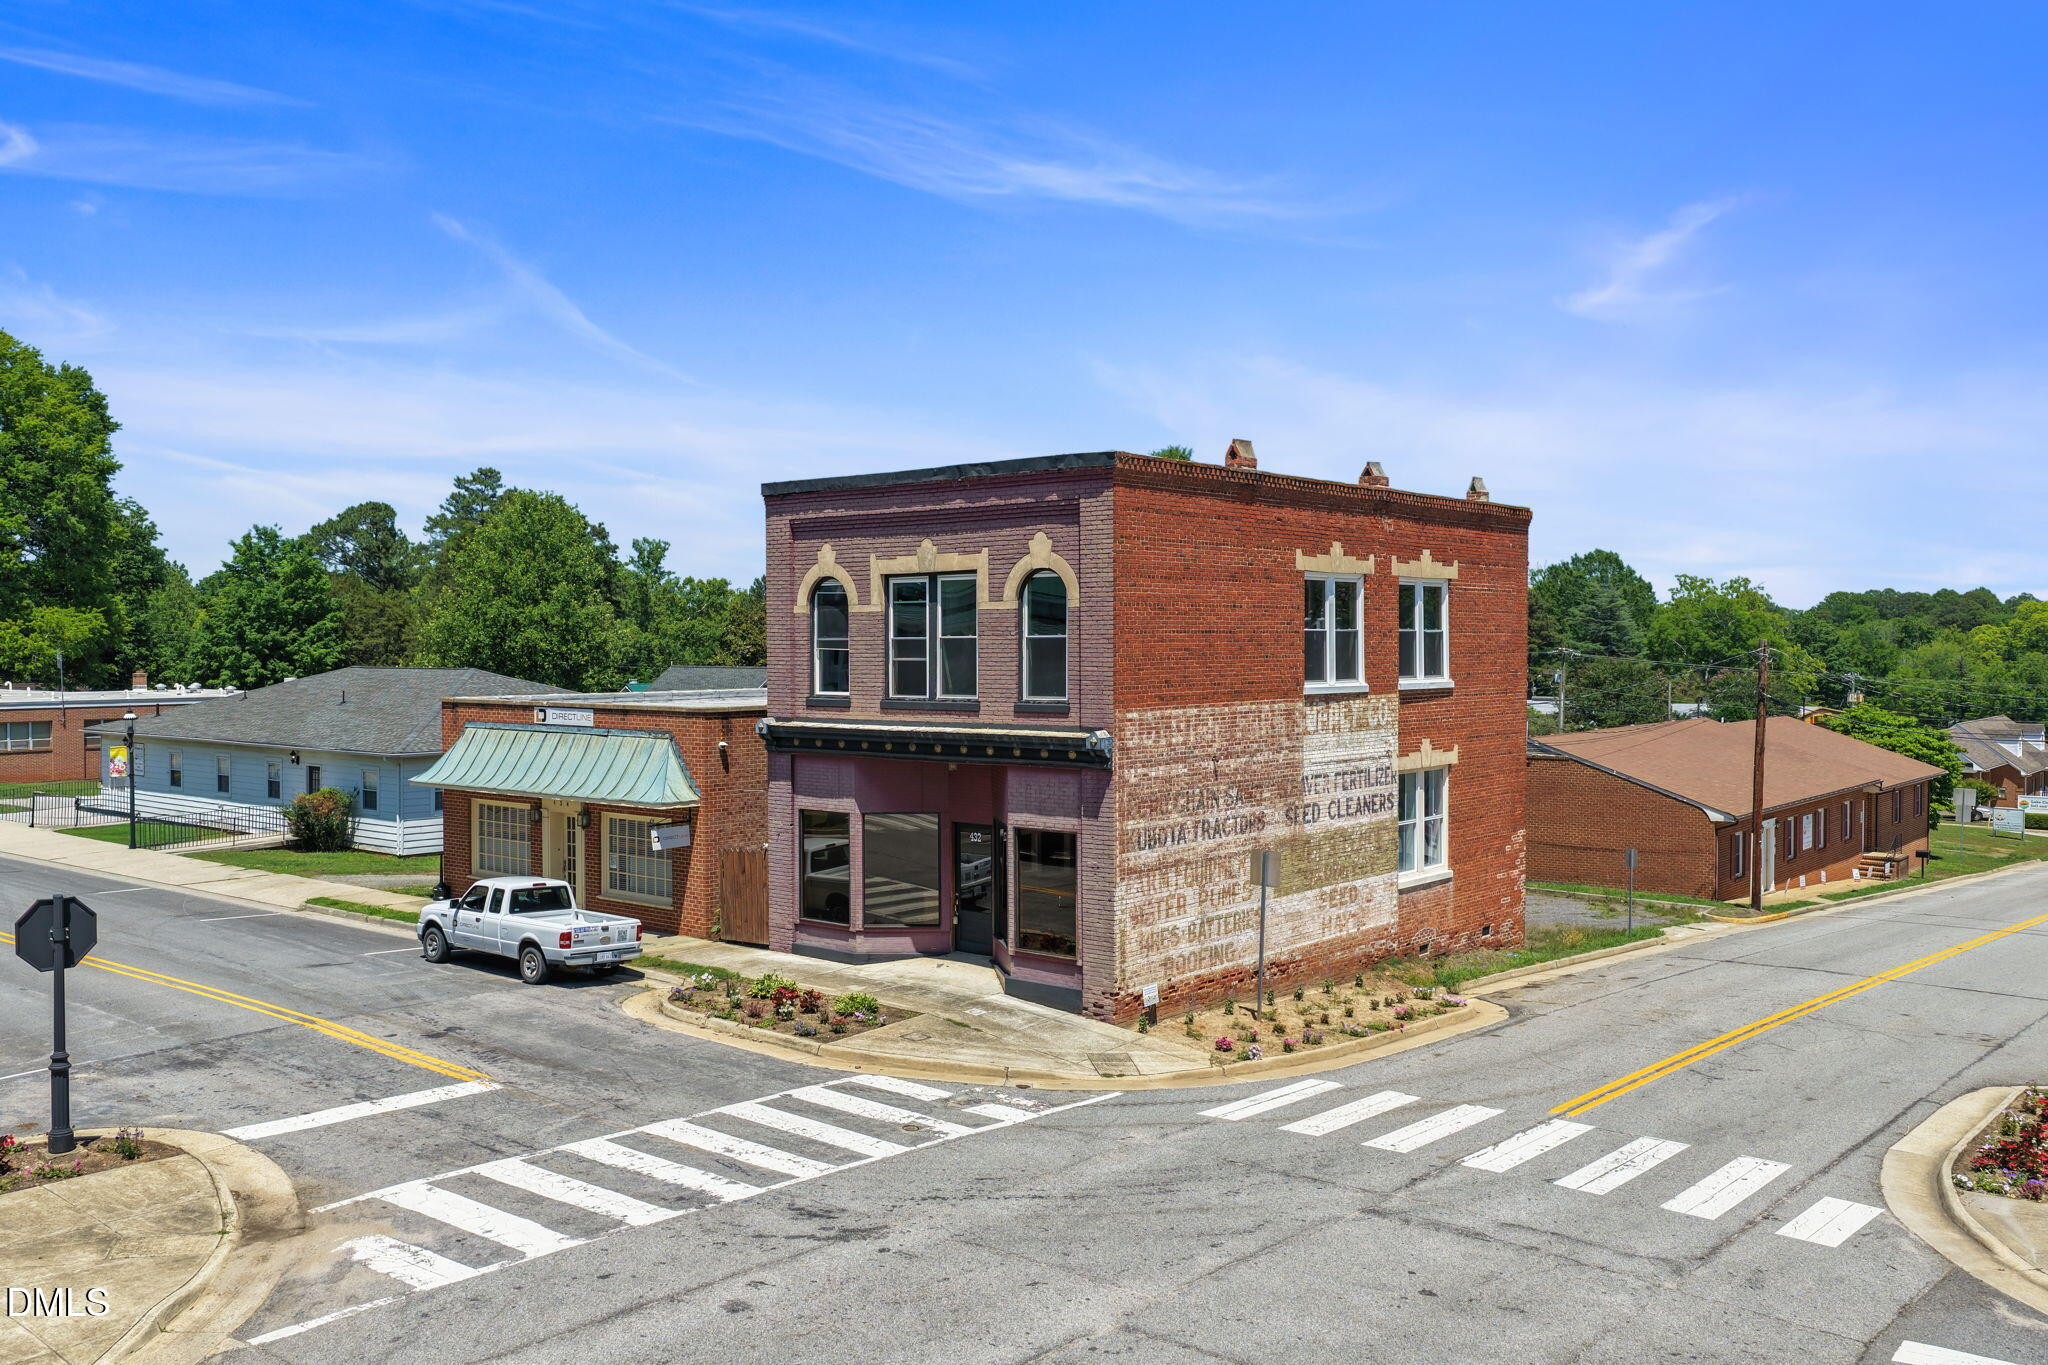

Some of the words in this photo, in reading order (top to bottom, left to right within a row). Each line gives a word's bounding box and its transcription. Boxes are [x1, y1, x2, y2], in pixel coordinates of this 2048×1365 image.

[551, 712, 592, 722] DIRECTLINE
[1284, 800, 1321, 827] SEED
[1327, 791, 1395, 821] CLEANERS
[970, 832, 982, 842] 432
